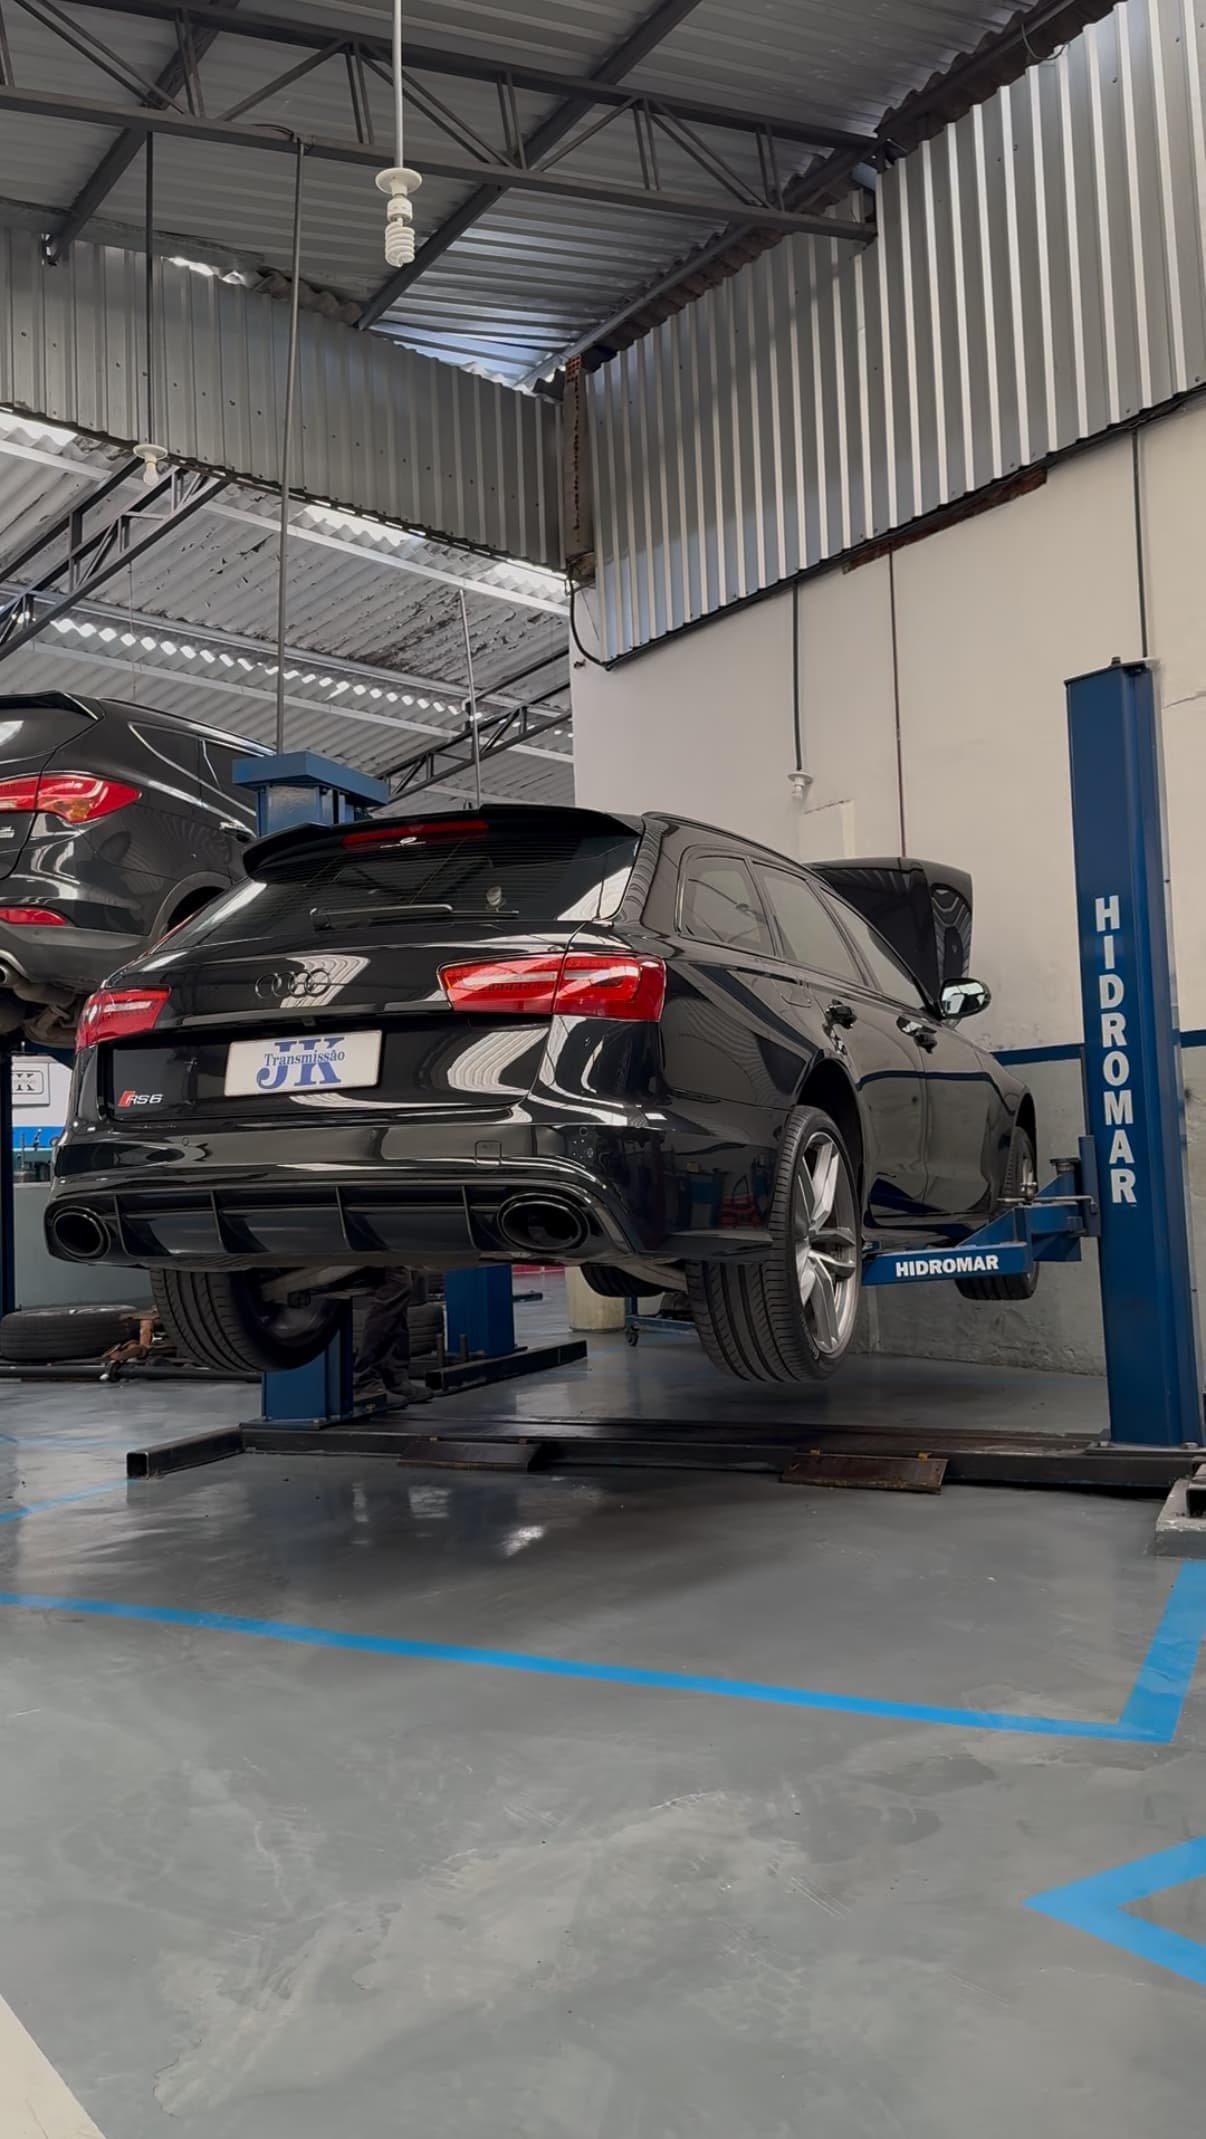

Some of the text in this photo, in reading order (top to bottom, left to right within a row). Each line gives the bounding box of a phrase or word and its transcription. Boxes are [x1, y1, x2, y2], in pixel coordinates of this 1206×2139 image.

[264, 1050, 346, 1067] Transmissão
[1095, 895, 1137, 1203] HIDROMAR
[256, 1036, 345, 1090] JK
[124, 1093, 164, 1105] RS6
[895, 1254, 999, 1278] HIDROMAR
